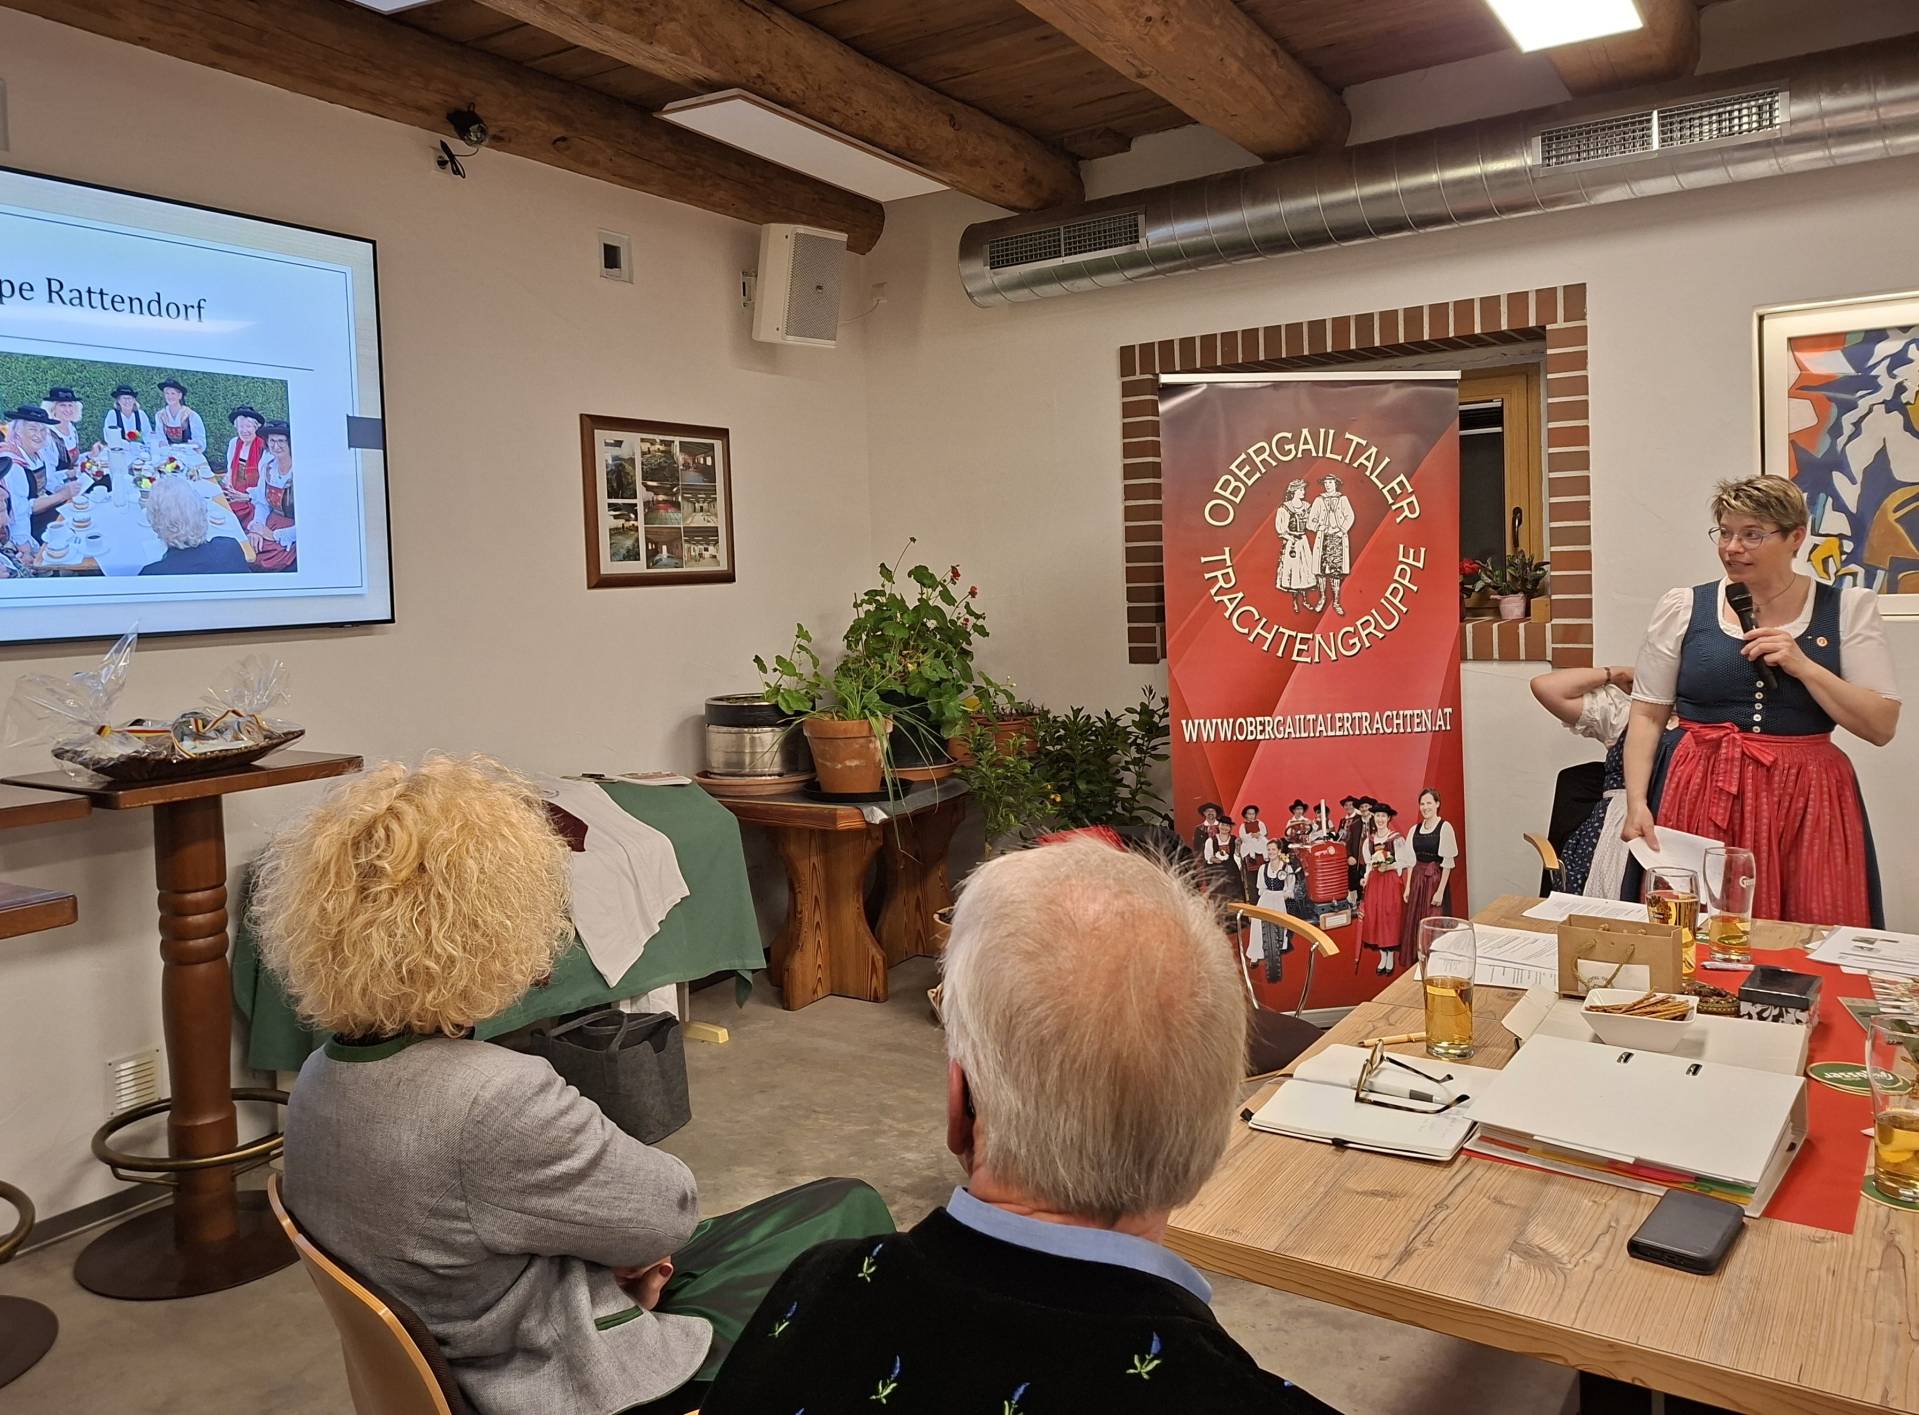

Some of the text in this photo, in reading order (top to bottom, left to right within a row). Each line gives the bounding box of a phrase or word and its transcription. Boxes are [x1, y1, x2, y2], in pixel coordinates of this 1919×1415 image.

[45, 277, 207, 323] Rattendorf
[1204, 427, 1421, 528] OBERGAILTALER
[1200, 544, 1426, 664] TRACHTENGRUPPE
[1181, 707, 1453, 743] WWW.OBERGAILTALERTRACHTEN.AT
